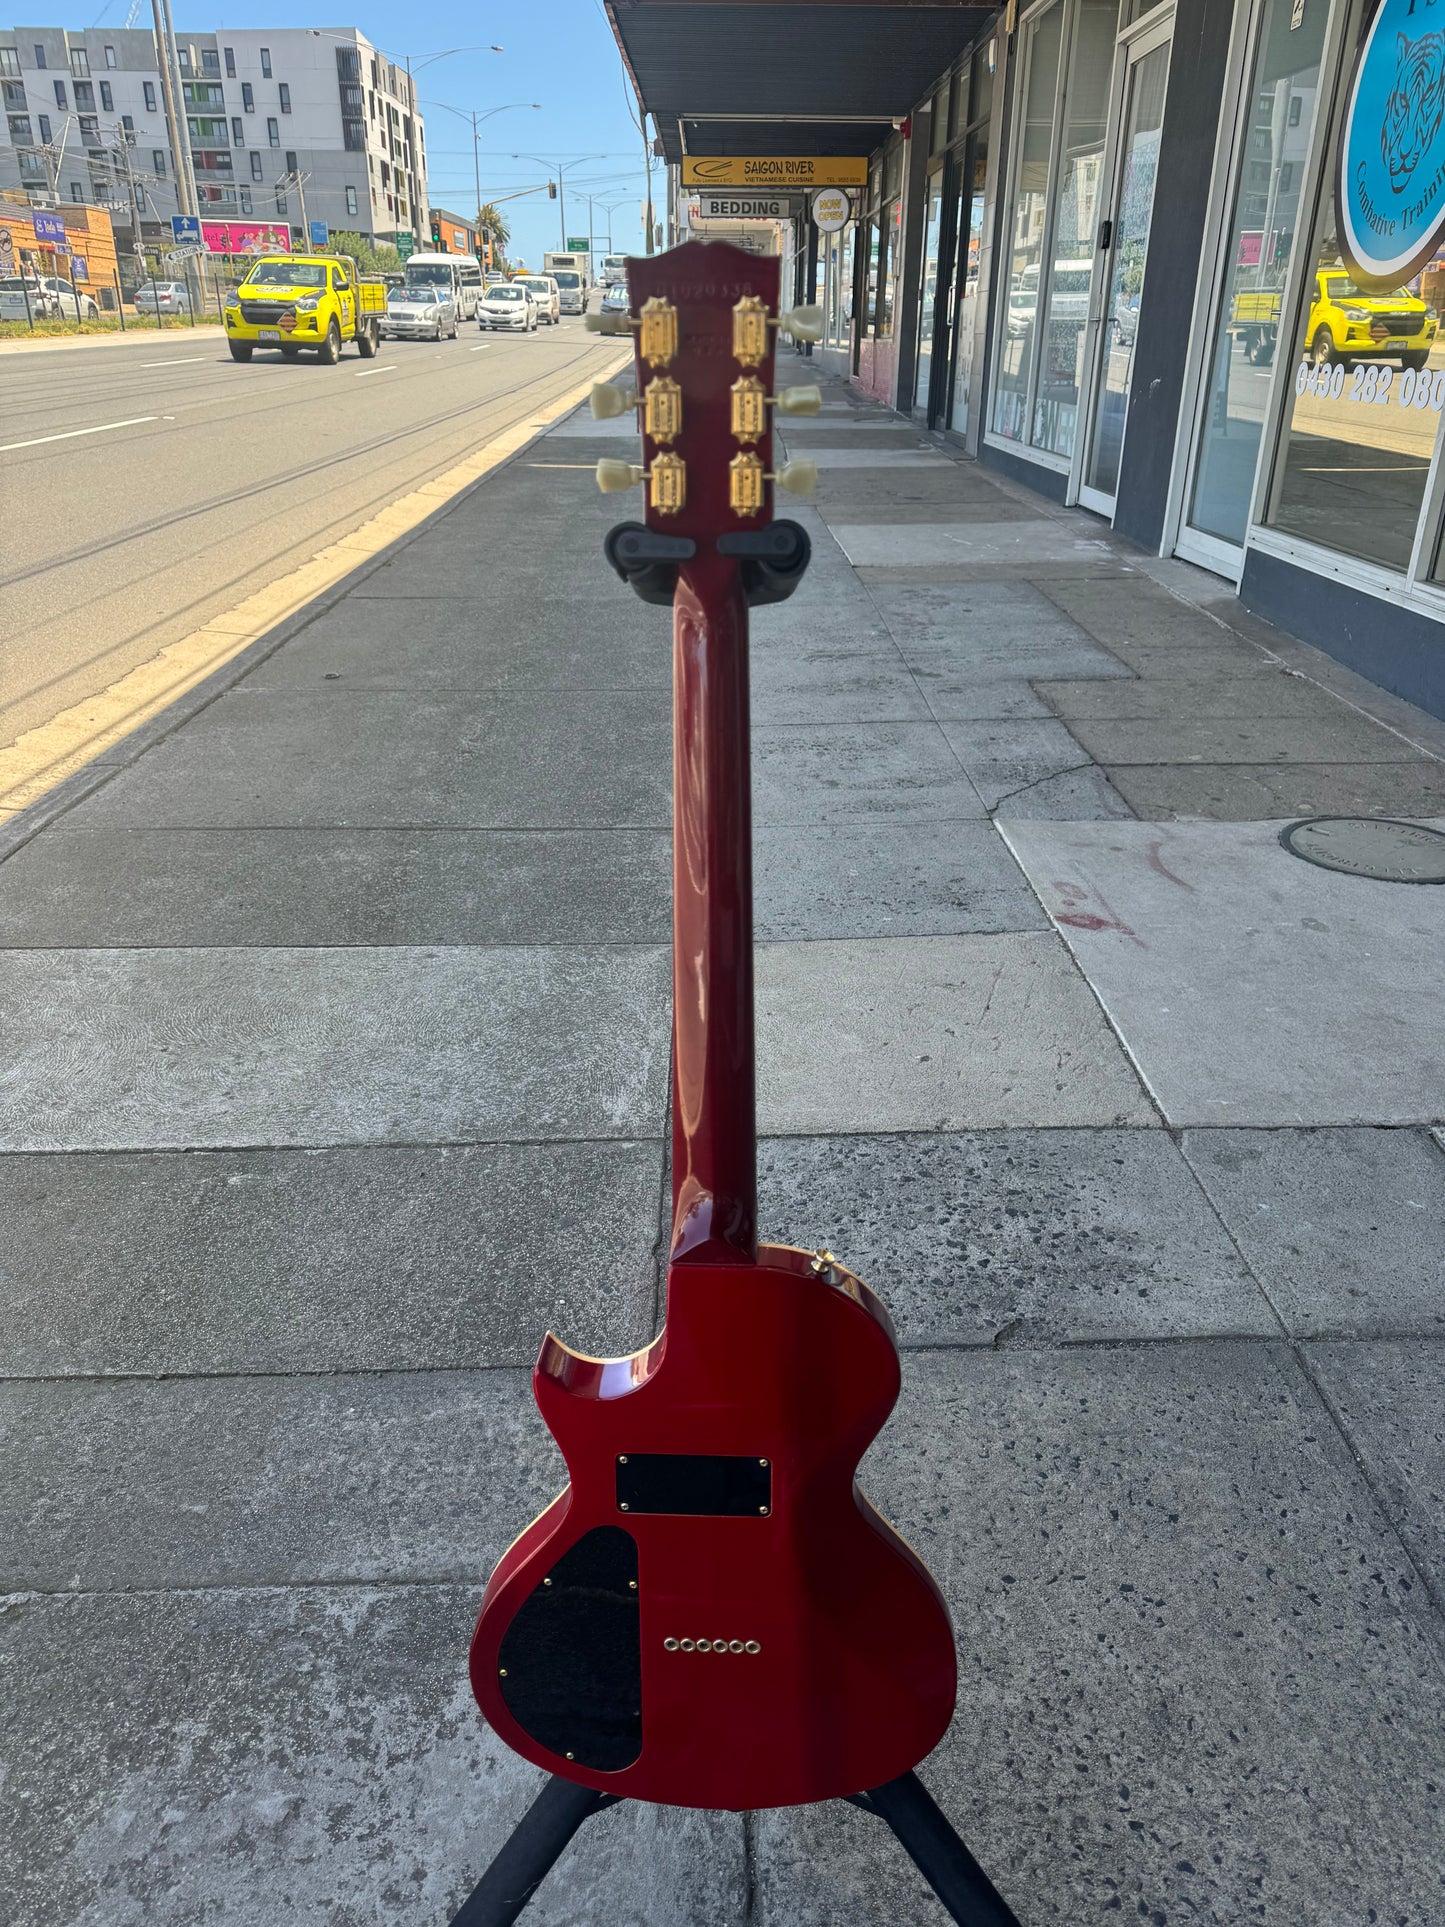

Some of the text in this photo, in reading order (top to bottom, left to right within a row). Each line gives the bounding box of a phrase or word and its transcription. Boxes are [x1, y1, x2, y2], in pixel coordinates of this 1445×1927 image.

[744, 161, 815, 174] SAIGON RIVER
[819, 198, 842, 210] NOW
[1357, 161, 1396, 236] Combative
[710, 201, 780, 215] BEDDING
[818, 211, 844, 221] OPEN
[175, 246, 198, 258] STATION
[1295, 362, 1445, 411] 0430 282 080
